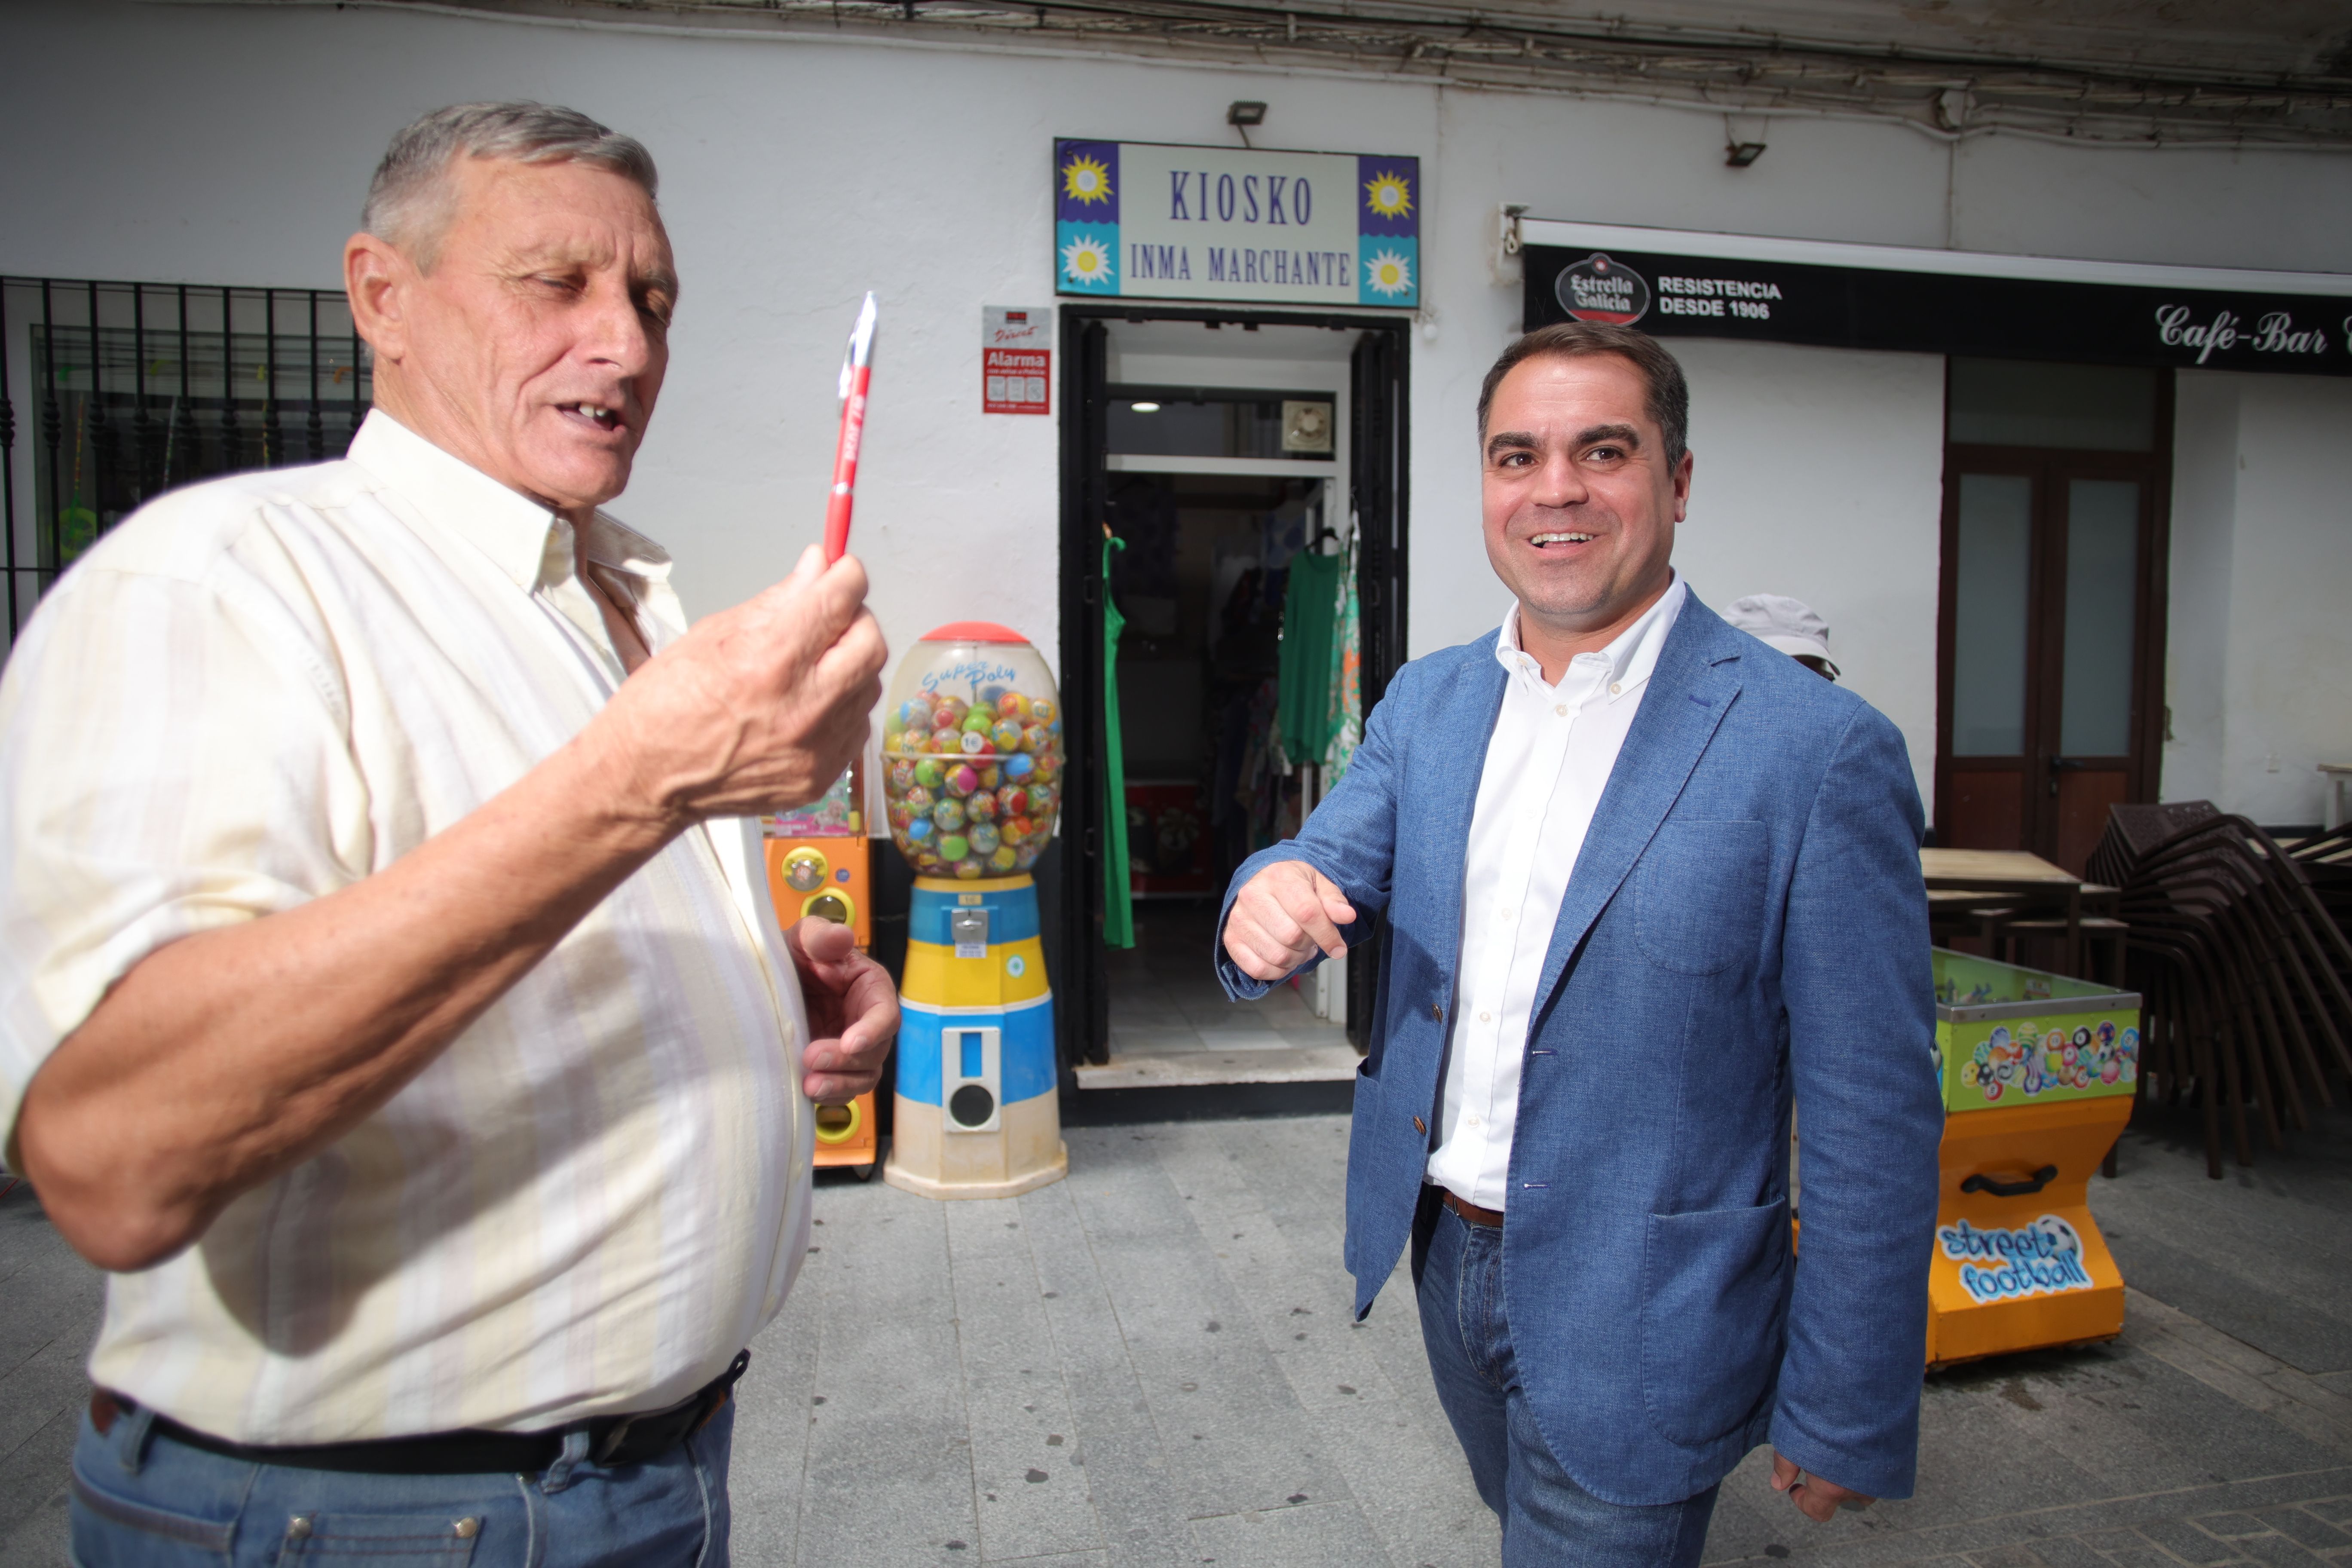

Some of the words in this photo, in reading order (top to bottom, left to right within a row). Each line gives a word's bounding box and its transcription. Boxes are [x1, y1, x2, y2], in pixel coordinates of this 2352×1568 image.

[1169, 170, 1311, 225] KIOSKO
[1130, 243, 1191, 280] INMA
[1207, 247, 1351, 287] MARCHANTE
[1571, 273, 1634, 295] Estrella
[1658, 276, 1783, 300] RESISTENCIA
[1574, 290, 1632, 312] Galicia
[1659, 296, 1725, 317] DESDE
[1728, 300, 1770, 320] 1906
[2155, 303, 2328, 365] Café-Bar
[987, 350, 1046, 367] Alarma
[922, 661, 989, 694] Super
[965, 665, 1016, 690] Poly
[1939, 1221, 2054, 1259] street
[1963, 1250, 2089, 1298] football
